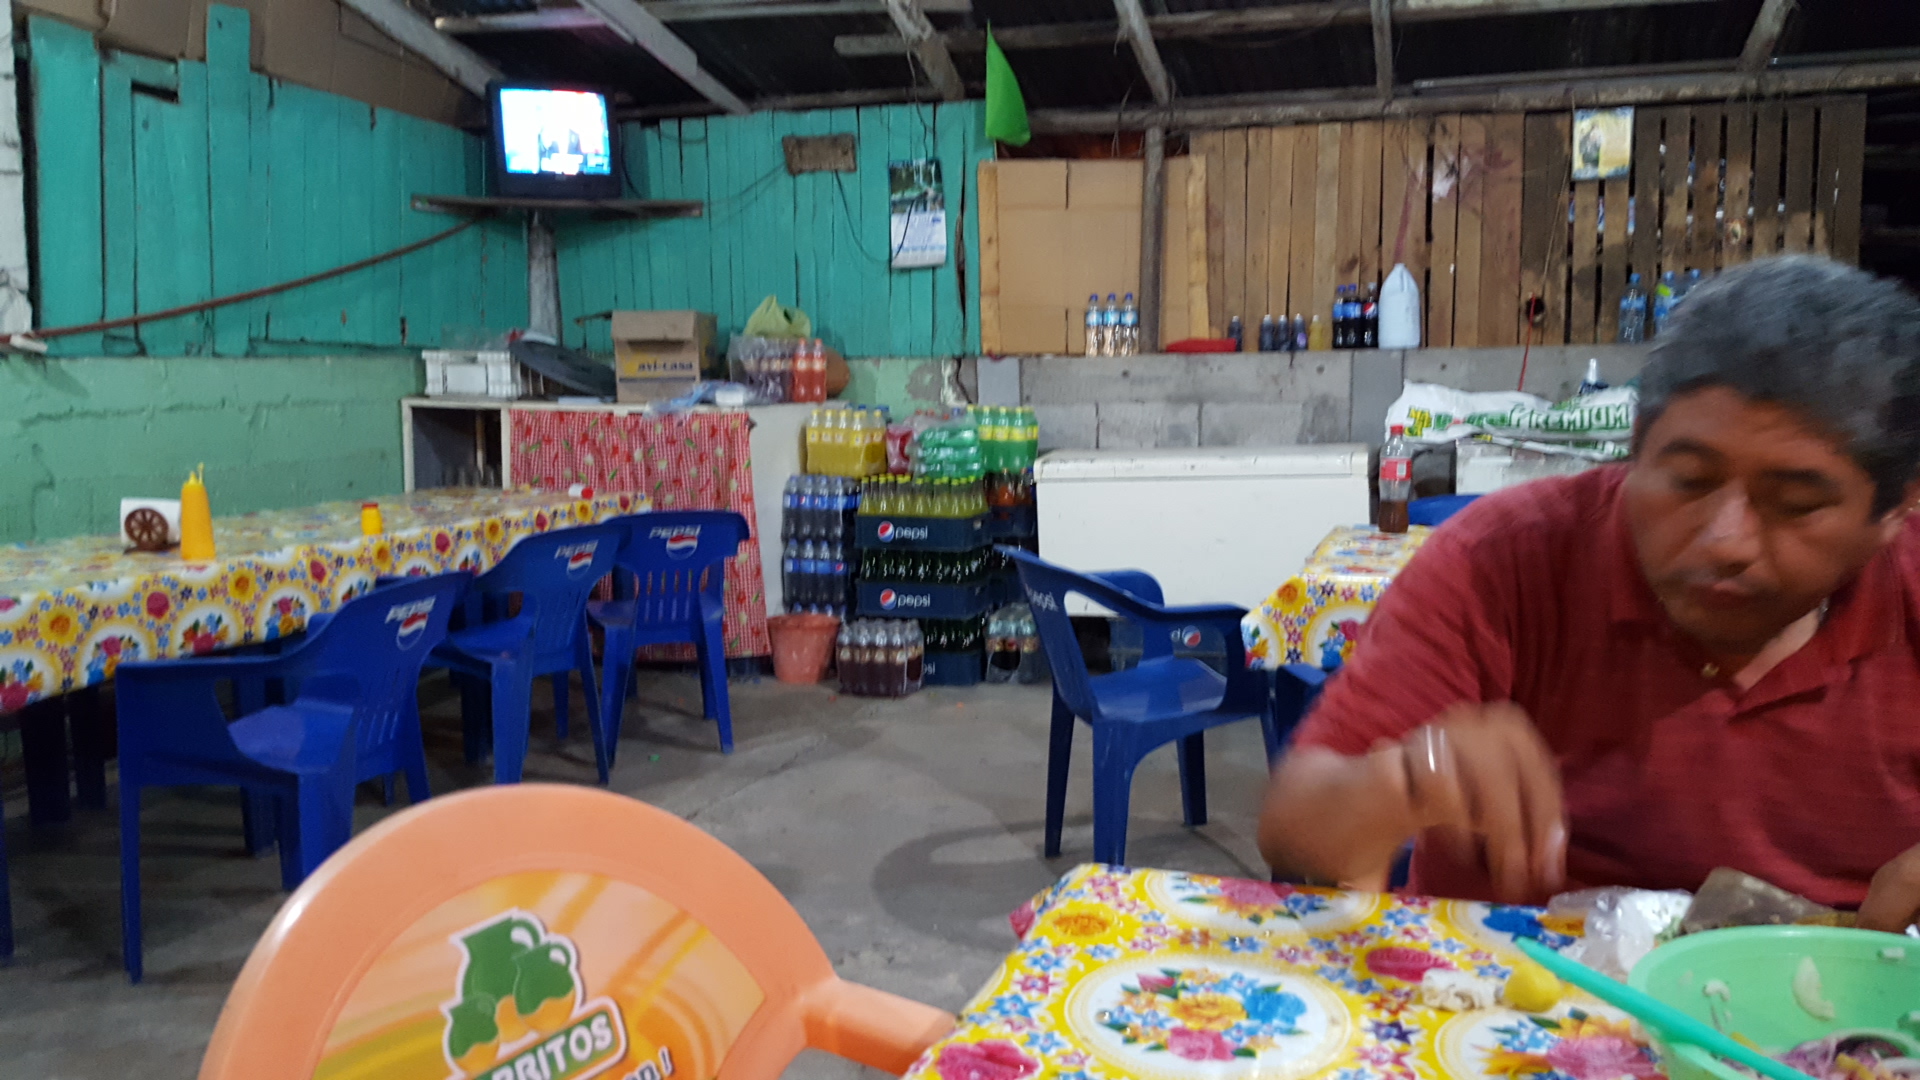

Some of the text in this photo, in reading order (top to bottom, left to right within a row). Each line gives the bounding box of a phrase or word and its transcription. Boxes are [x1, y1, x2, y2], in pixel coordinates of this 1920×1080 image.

[649, 524, 702, 539] PEPSI
[895, 526, 928, 540] pepsi
[554, 540, 599, 559] PEPSI
[897, 594, 931, 608] pepsi
[385, 595, 436, 624] PEPSI
